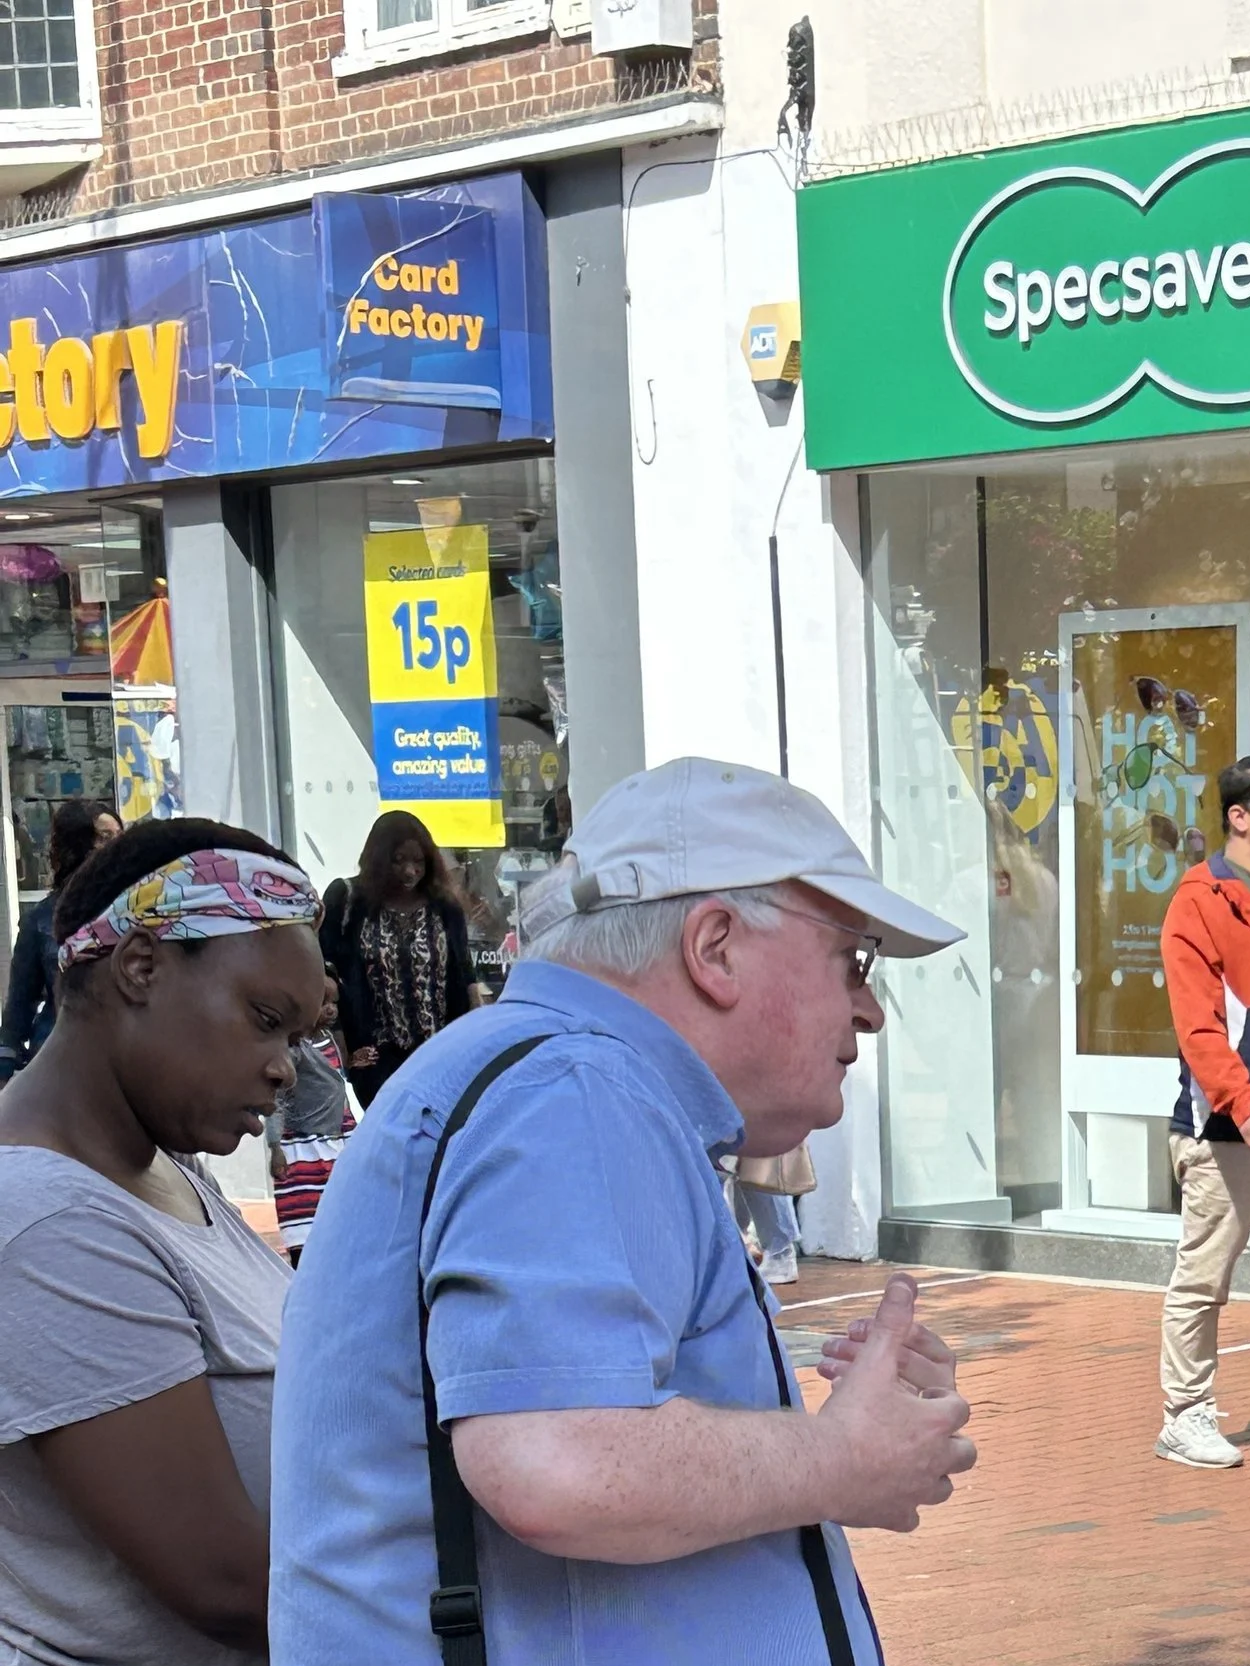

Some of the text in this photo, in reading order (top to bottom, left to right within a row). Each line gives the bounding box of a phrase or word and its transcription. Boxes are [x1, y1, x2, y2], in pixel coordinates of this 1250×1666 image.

[374, 256, 459, 295] Card
[349, 299, 484, 351] Factory
[751, 332, 776, 353] ADT
[392, 600, 470, 684] 15p
[394, 726, 482, 751] Great quality,
[392, 756, 447, 779] amazing
[451, 753, 487, 775] value
